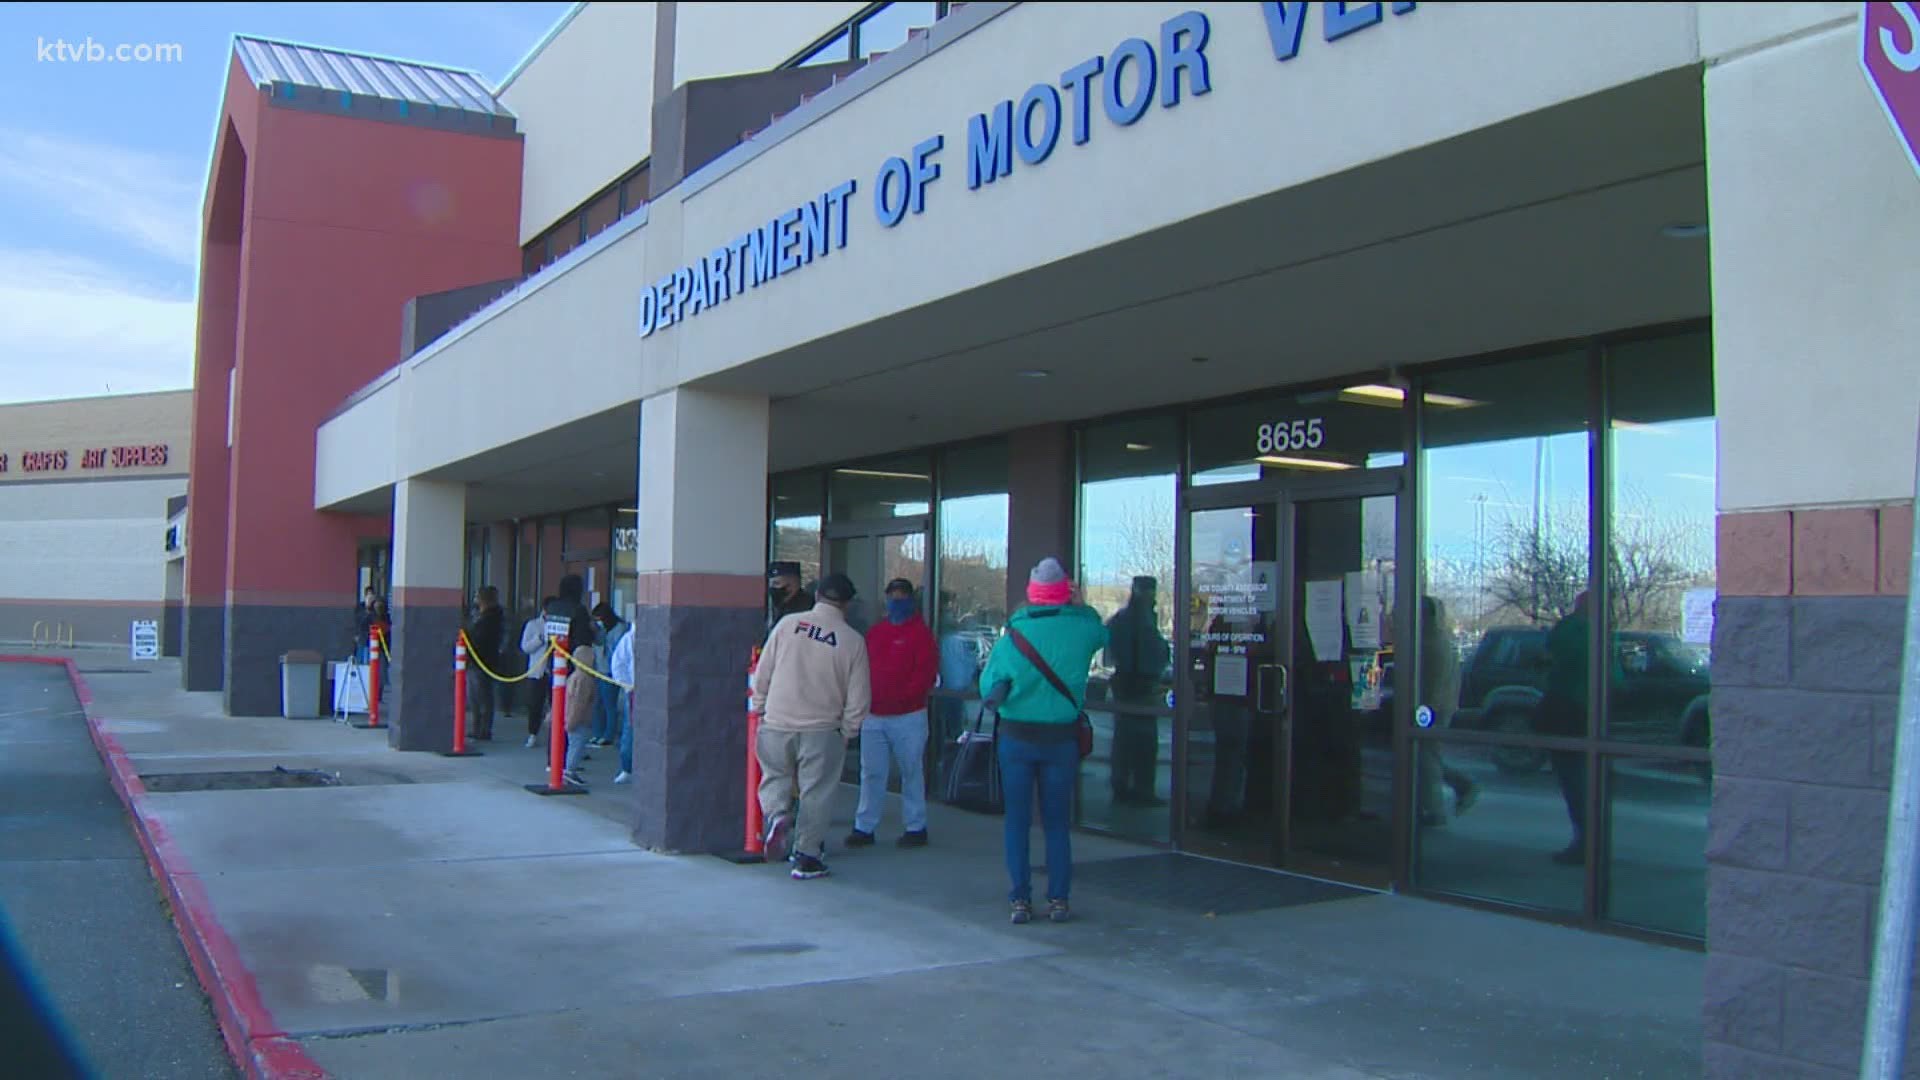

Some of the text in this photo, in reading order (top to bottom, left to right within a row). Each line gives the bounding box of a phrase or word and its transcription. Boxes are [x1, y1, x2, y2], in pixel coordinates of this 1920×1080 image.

[639, 179, 857, 339] DEPARTMENT
[874, 133, 945, 228] OF
[967, 10, 1212, 190] MOTOR
[1256, 417, 1324, 454] 8655
[22, 450, 68, 473] CRAFTS
[80, 448, 107, 469] ART
[111, 444, 168, 468] SUPPLIES
[794, 621, 838, 648] FILA
